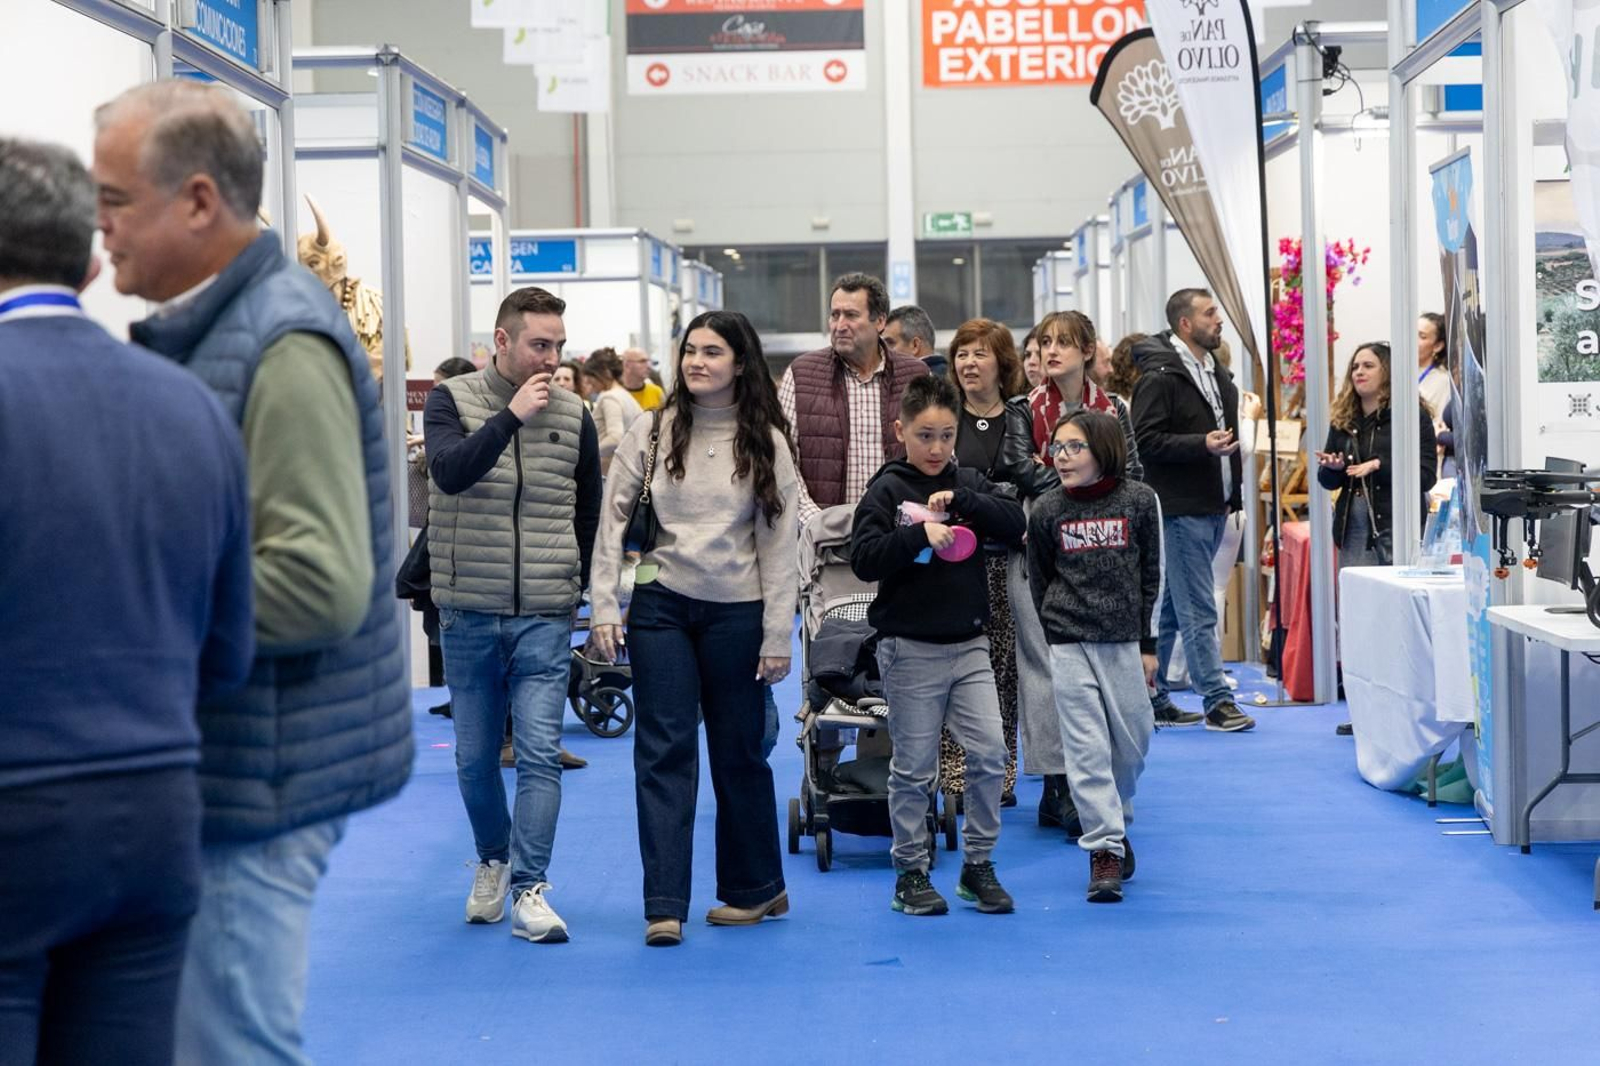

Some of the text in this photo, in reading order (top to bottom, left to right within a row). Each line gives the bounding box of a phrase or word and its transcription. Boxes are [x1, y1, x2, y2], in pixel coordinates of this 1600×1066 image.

[683, 63, 813, 83] SNACK BAR
[939, 44, 1108, 81] EXTERIO
[1061, 520, 1126, 550] MARVEL
